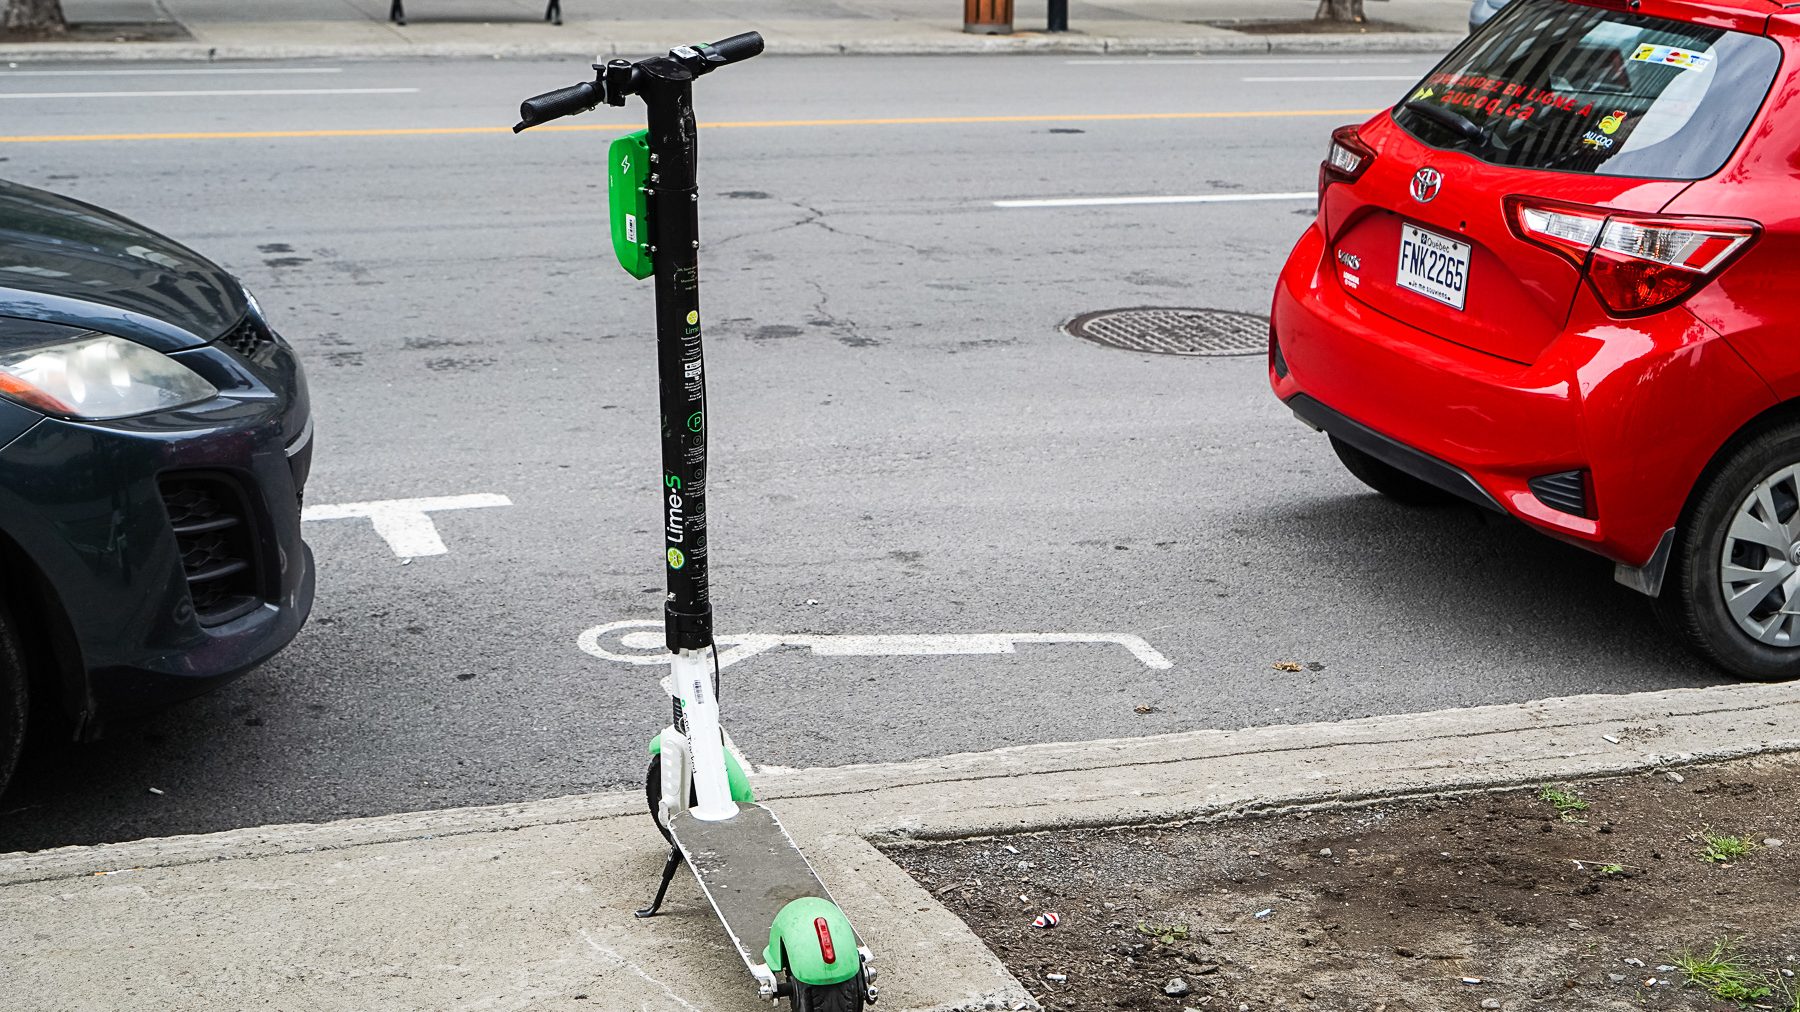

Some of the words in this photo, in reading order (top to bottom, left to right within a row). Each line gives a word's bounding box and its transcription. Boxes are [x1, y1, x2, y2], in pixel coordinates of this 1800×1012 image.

[1440, 89, 1535, 121] aucoq.ca
[1502, 83, 1527, 98] EN
[1526, 88, 1578, 111] LIGNE
[1427, 237, 1450, 254] Québec
[1400, 239, 1465, 292] FNK2265
